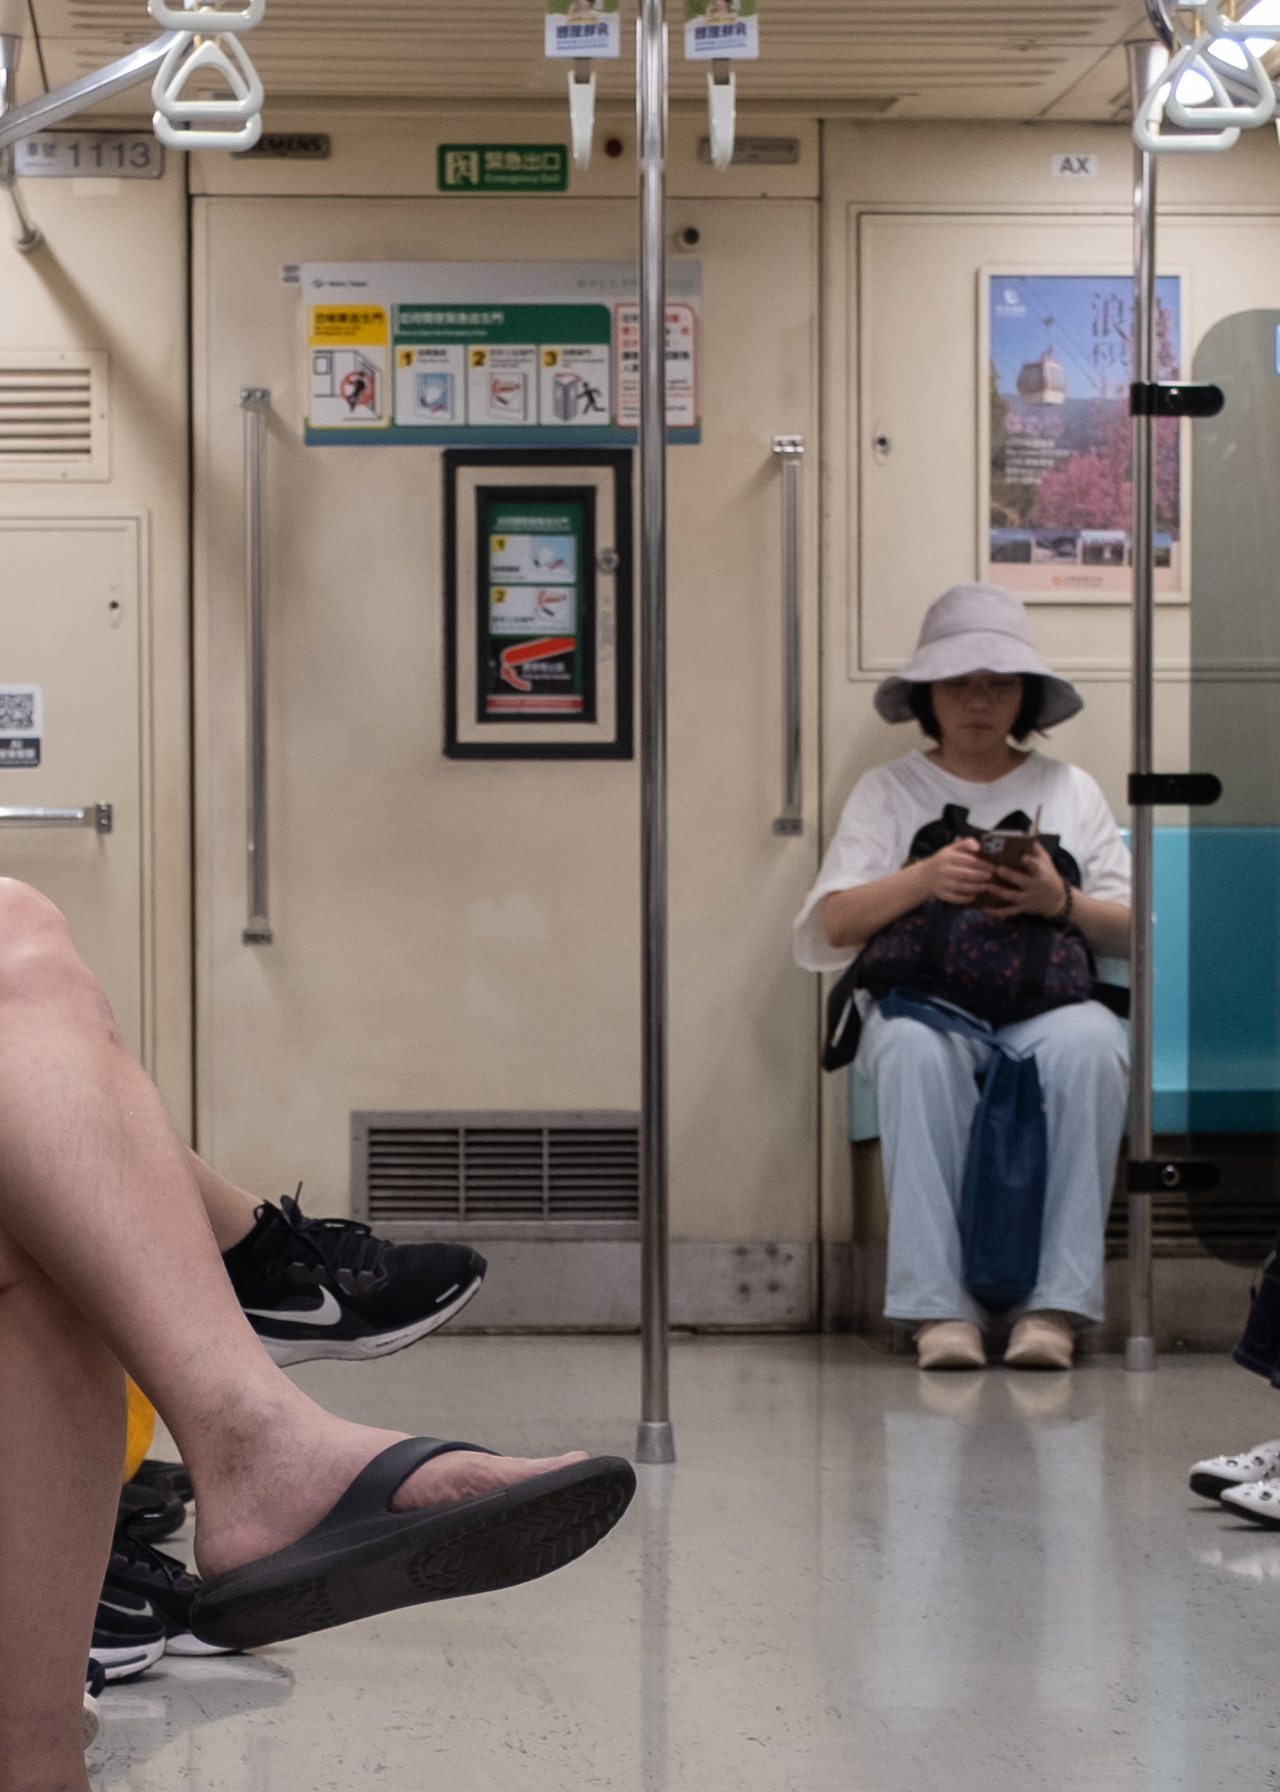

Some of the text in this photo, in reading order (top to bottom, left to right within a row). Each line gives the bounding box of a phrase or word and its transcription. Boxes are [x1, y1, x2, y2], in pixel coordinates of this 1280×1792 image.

[67, 141, 151, 169] 1113
[484, 151, 561, 171] 緊急出口
[1059, 156, 1090, 174] AX
